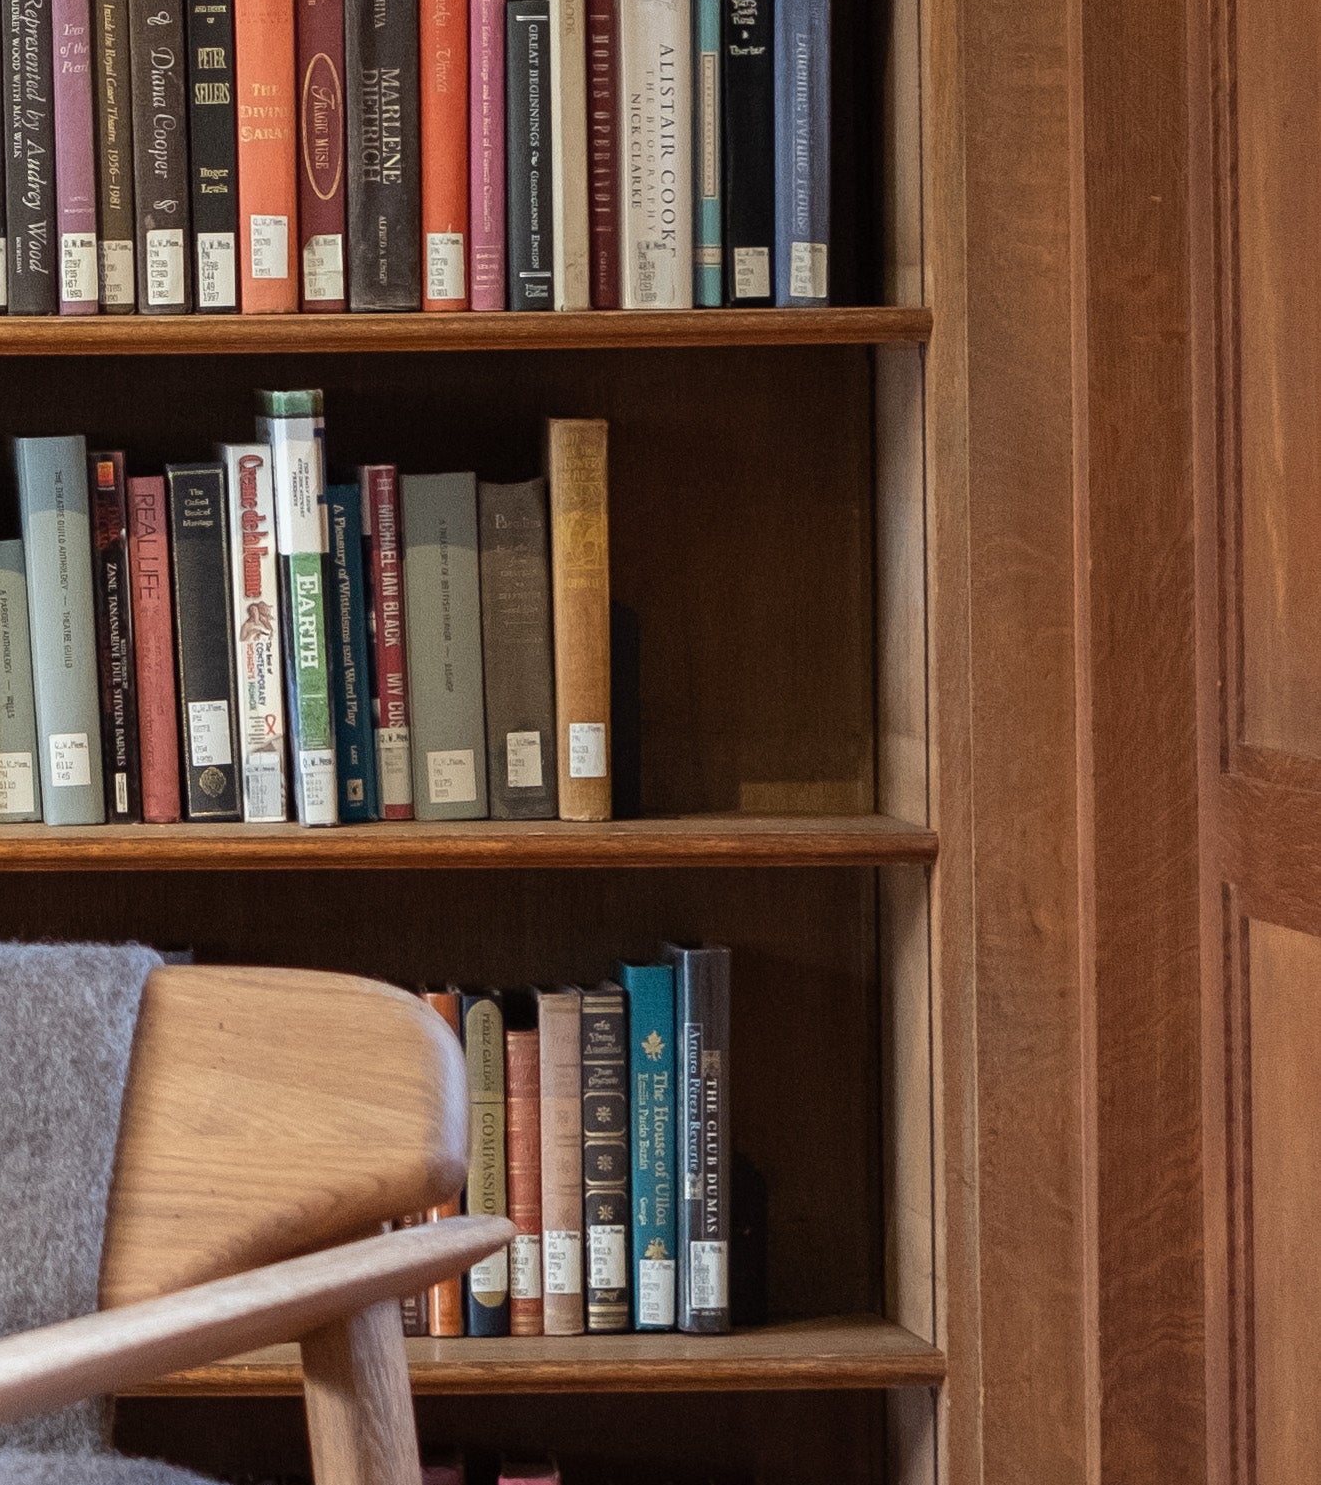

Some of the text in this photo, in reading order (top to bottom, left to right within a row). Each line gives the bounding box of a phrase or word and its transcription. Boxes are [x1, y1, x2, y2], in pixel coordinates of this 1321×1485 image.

[149, 47, 176, 179] Diana Cooper
[296, 573, 321, 669] EARTH
[653, 1072, 671, 1225] The House of Ulloa
[706, 1078, 718, 1233] THE CLUB DUMAS
